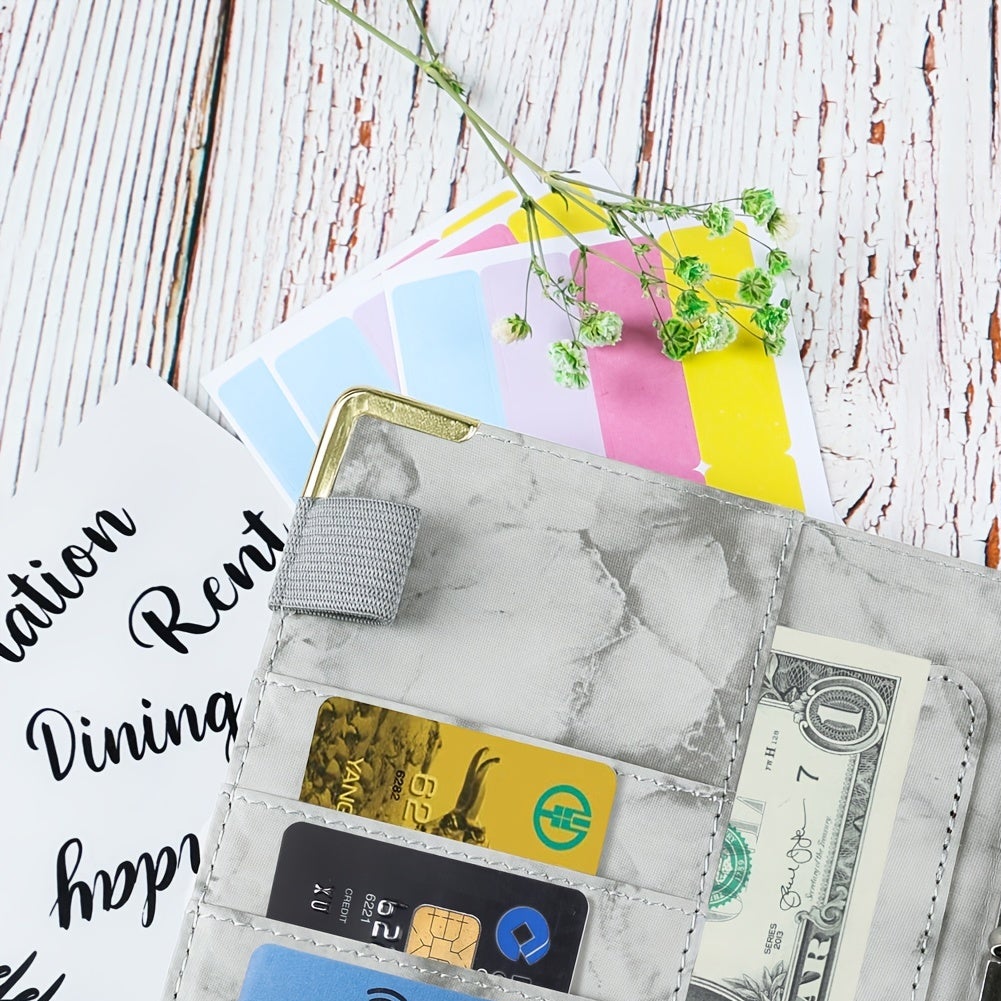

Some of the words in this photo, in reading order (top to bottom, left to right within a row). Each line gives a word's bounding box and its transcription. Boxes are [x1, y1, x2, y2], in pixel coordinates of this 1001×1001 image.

[129, 510, 289, 654] Rent
[26, 691, 242, 781] Dining
[797, 765, 819, 782] 7
[403, 773, 437, 824] 62
[339, 888, 353, 923] CREDIT
[360, 893, 376, 924] 6221
[764, 923, 777, 954] SERIES
[773, 929, 784, 951] 2013
